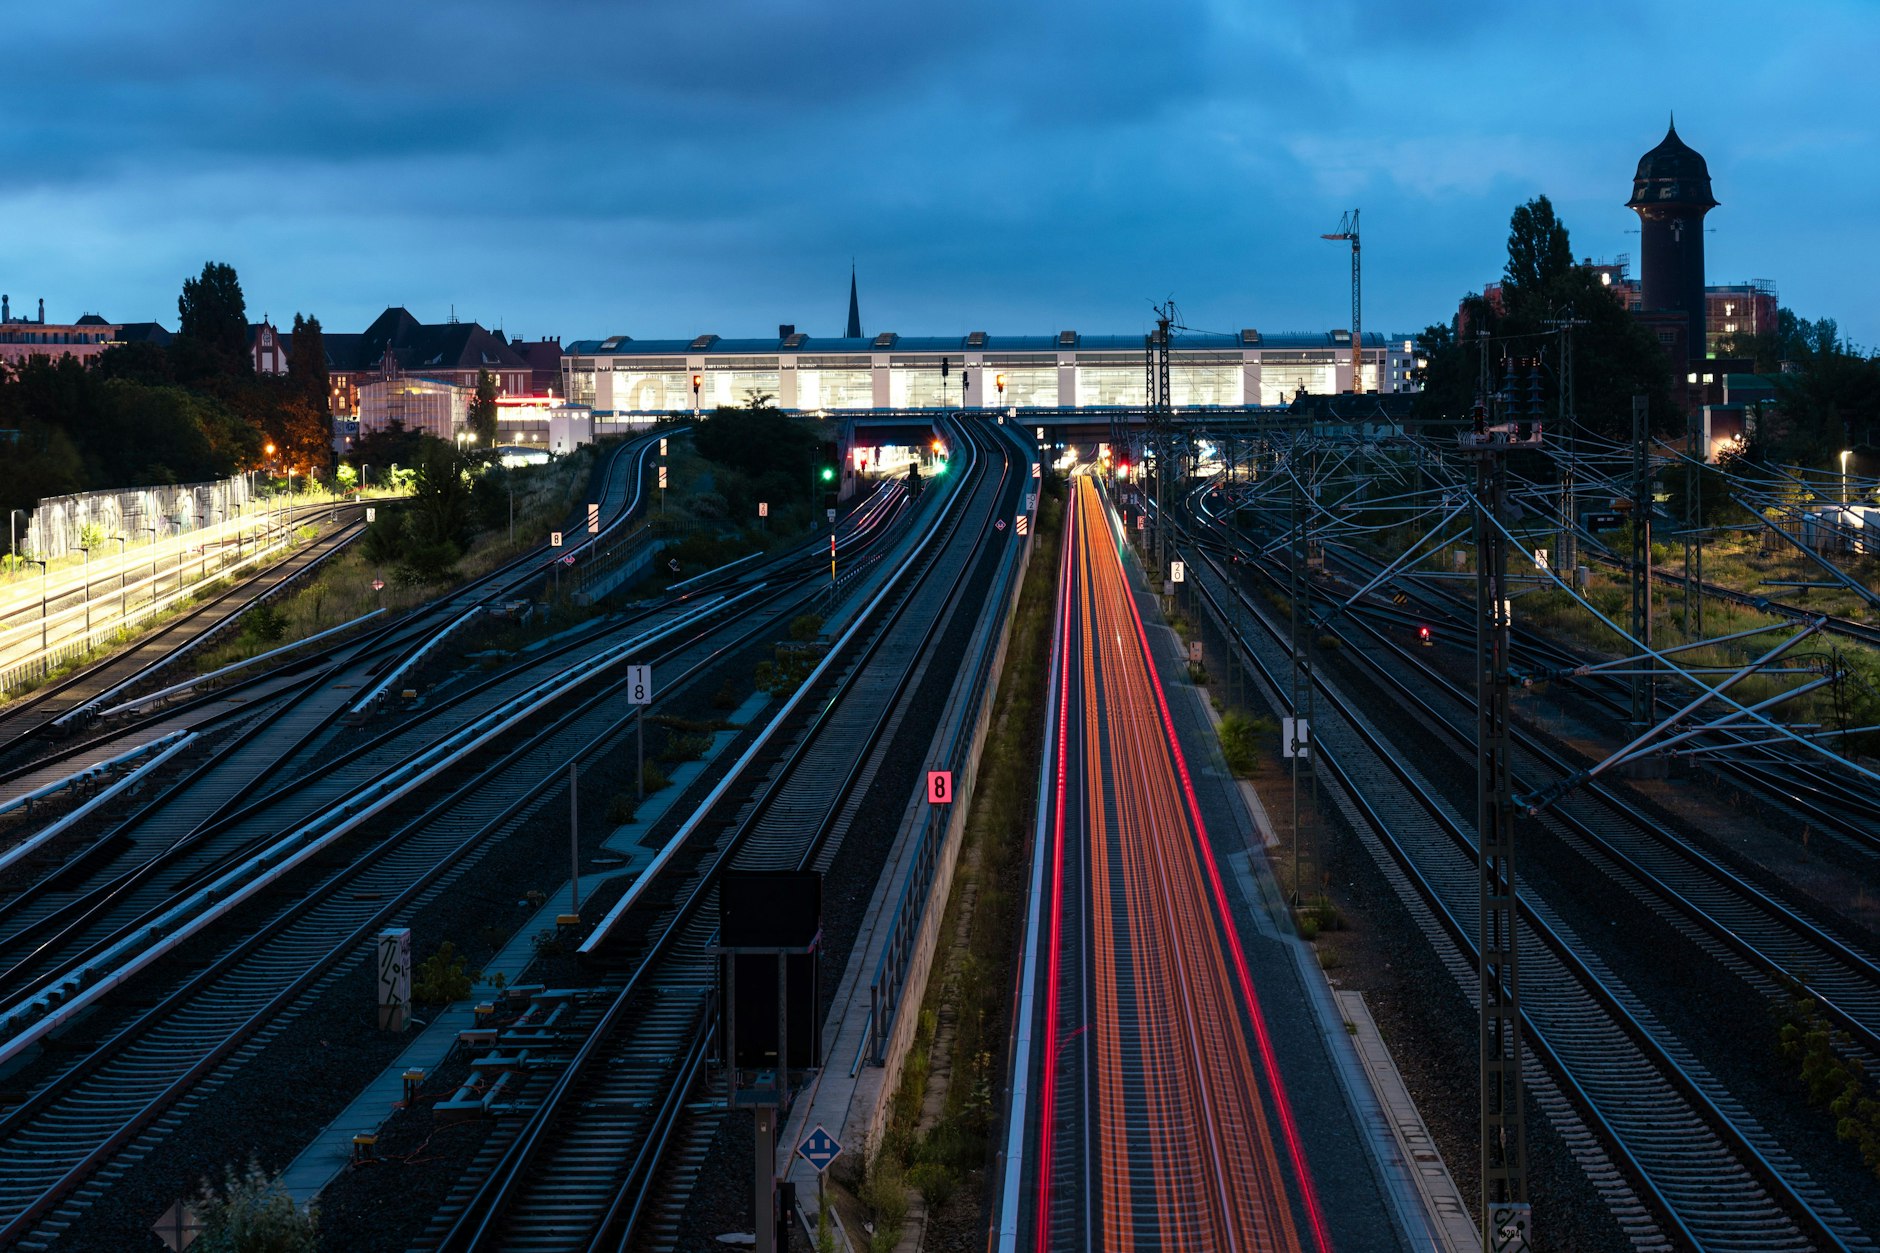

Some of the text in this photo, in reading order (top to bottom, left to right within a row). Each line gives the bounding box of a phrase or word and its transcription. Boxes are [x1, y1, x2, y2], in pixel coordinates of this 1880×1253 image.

[1175, 562, 1180, 571] 2
[1174, 571, 1181, 580] 0
[636, 668, 642, 683] 1
[634, 684, 644, 700] 8
[934, 775, 945, 798] 8
